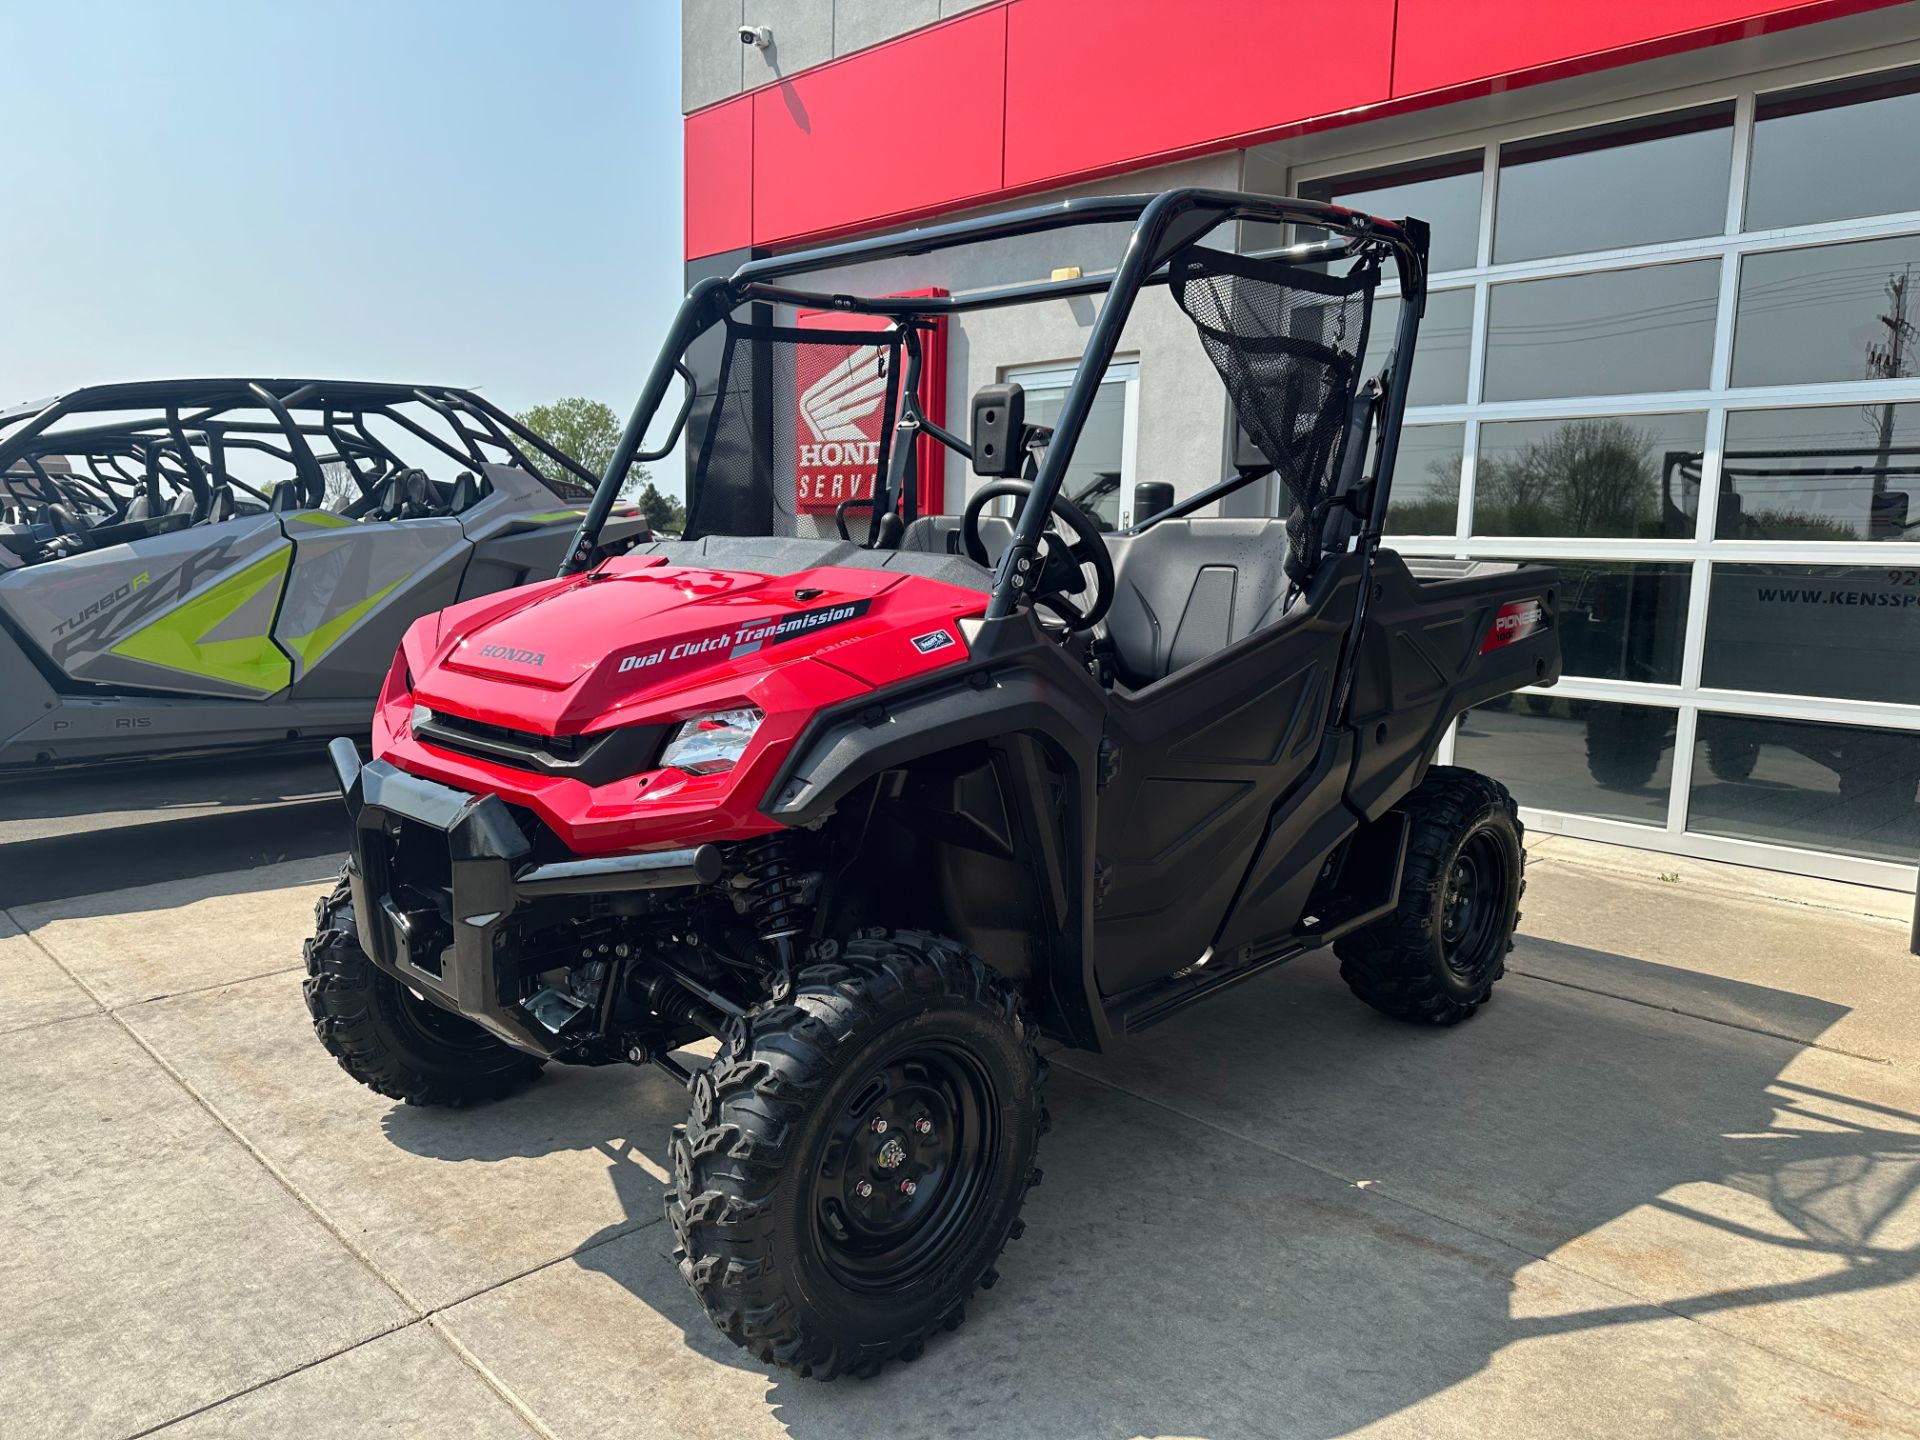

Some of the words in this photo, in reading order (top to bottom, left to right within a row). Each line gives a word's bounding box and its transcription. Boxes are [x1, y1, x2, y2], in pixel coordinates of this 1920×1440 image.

[799, 473, 877, 499] SERVI
[1887, 569, 1920, 587] 92
[51, 535, 242, 667] RZR
[52, 583, 131, 636] TURBO
[132, 570, 150, 593] R
[1495, 608, 1542, 632] PIONEER
[617, 648, 667, 673] Dual
[668, 633, 730, 660] Clutch
[734, 605, 856, 645] Transmission
[478, 644, 546, 667] HONDA
